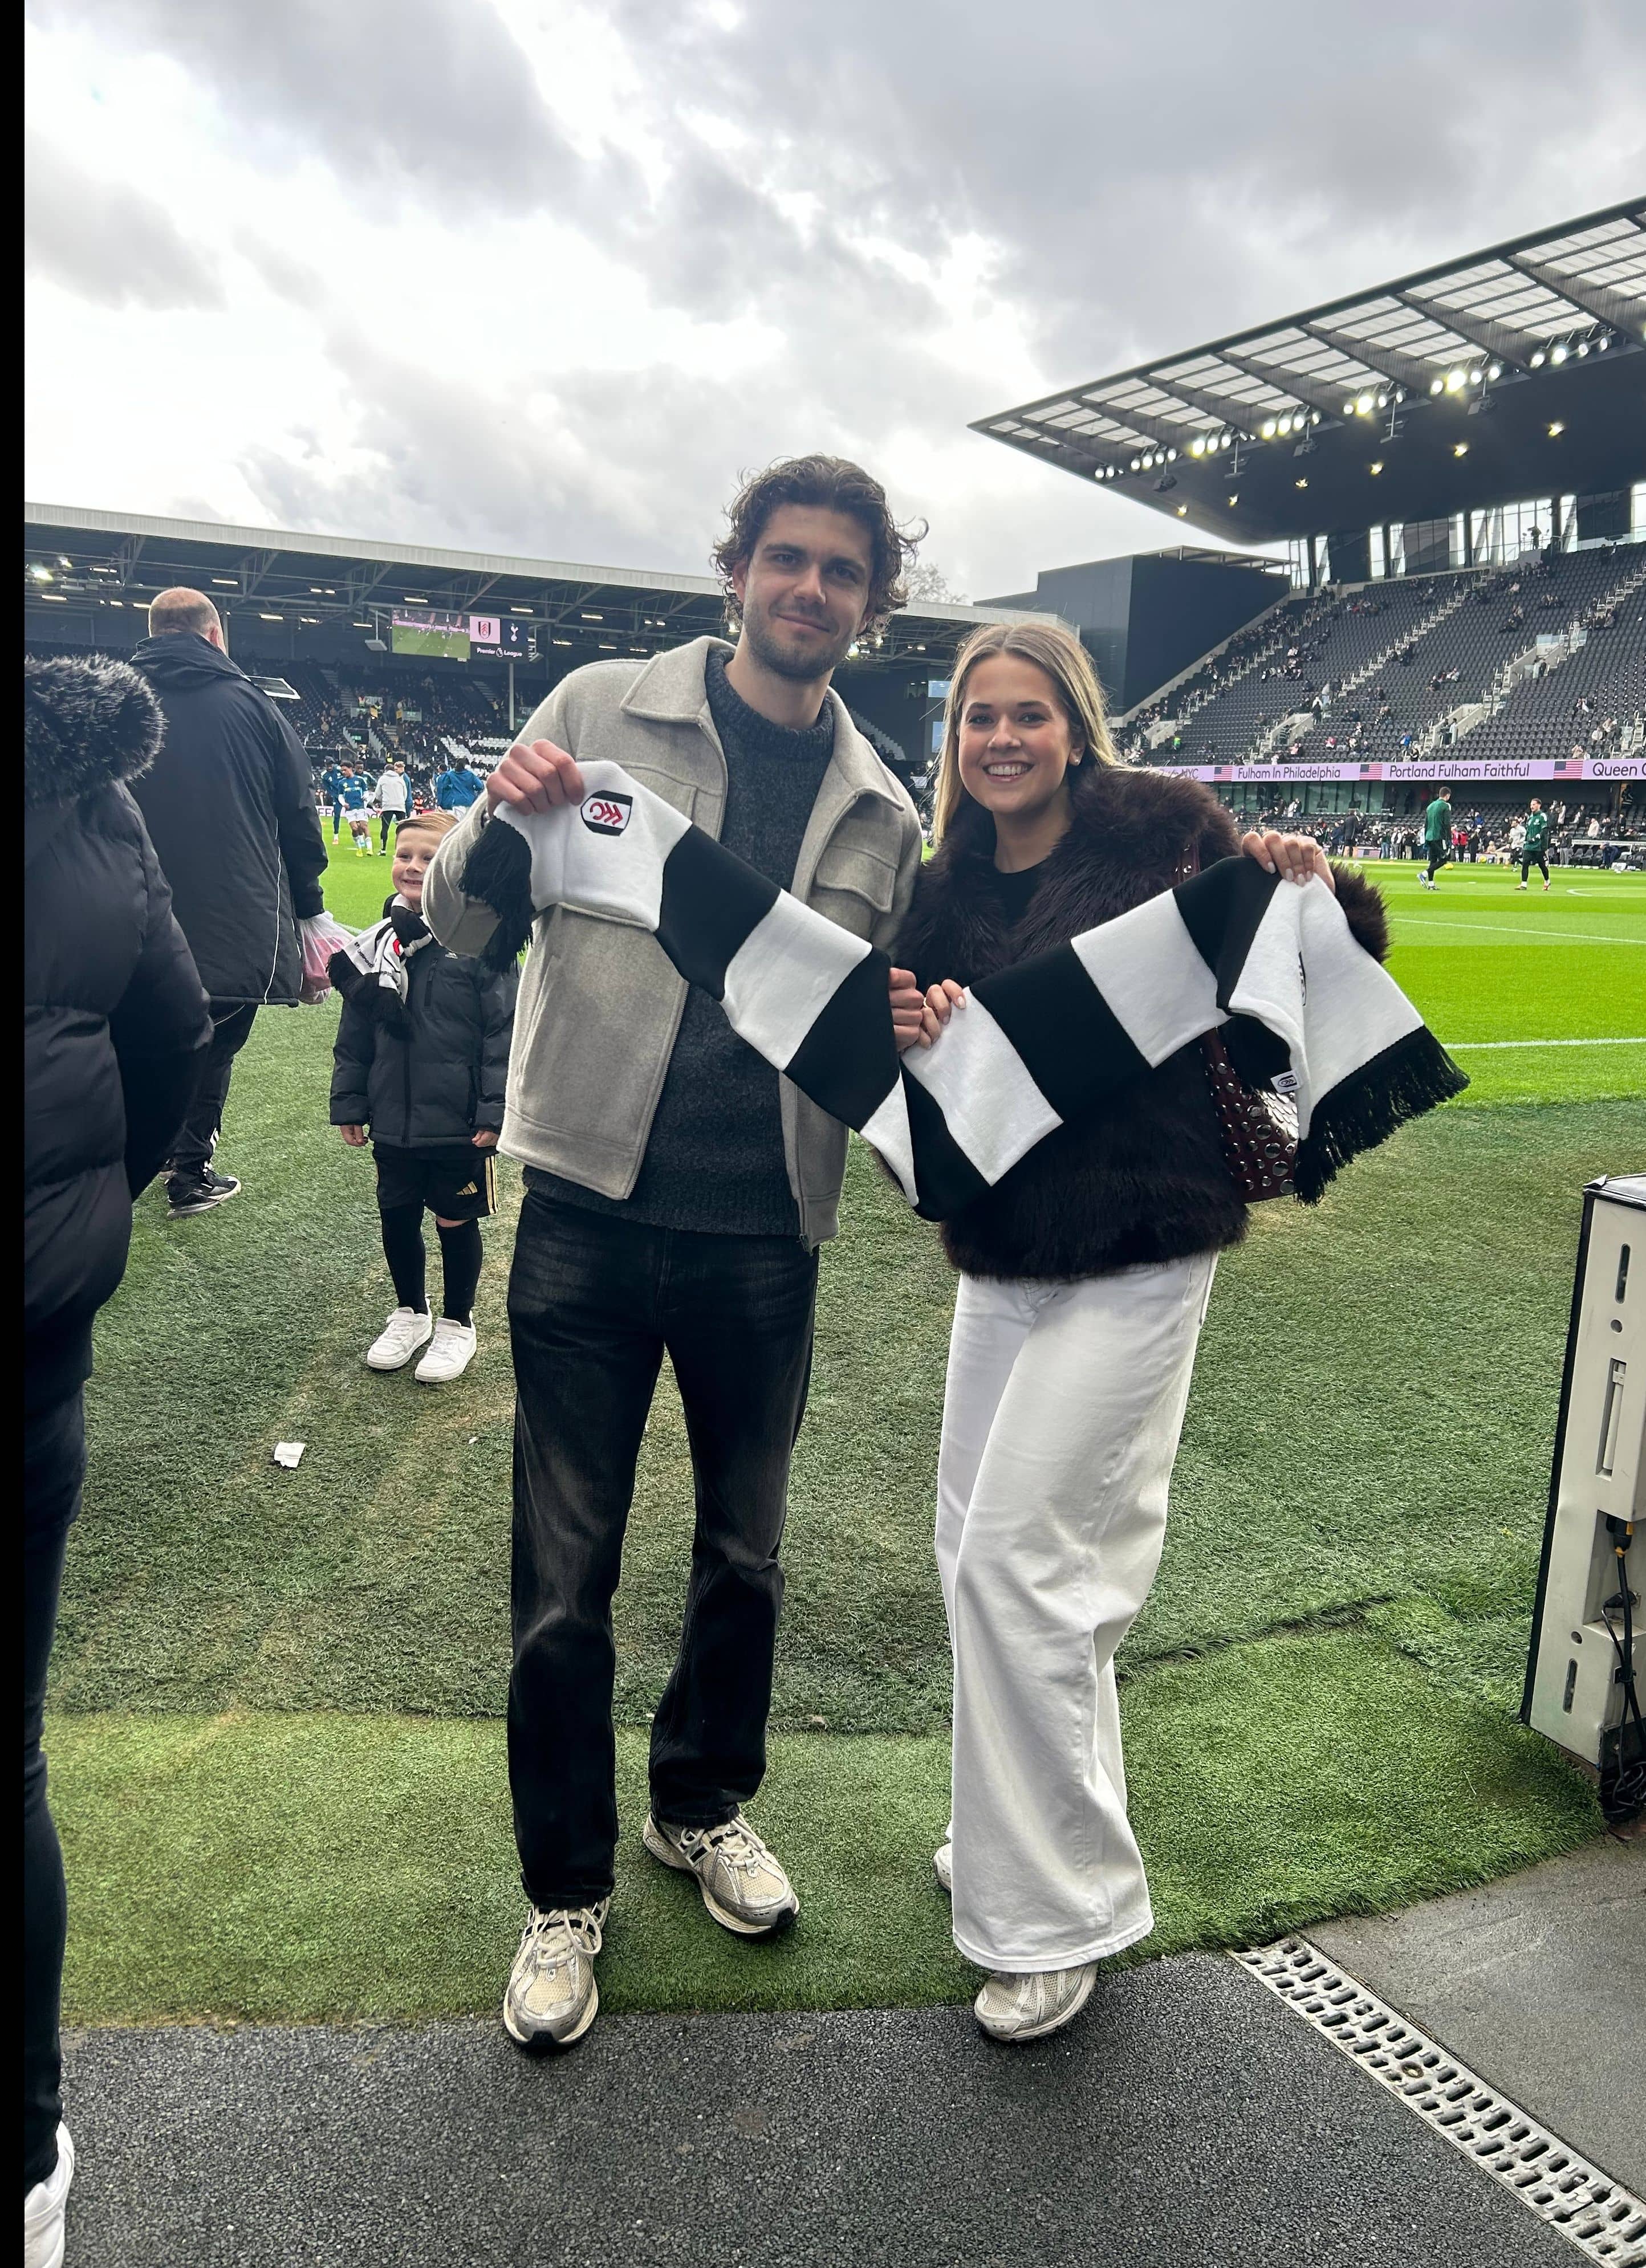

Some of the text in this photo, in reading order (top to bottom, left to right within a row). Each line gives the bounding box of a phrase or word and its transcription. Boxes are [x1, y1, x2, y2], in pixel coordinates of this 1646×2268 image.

[1238, 764, 1340, 780] Fulham In Philadelphia
[1389, 763, 1530, 777] Portland Fulham Faithful
[1593, 762, 1637, 776] Queen
